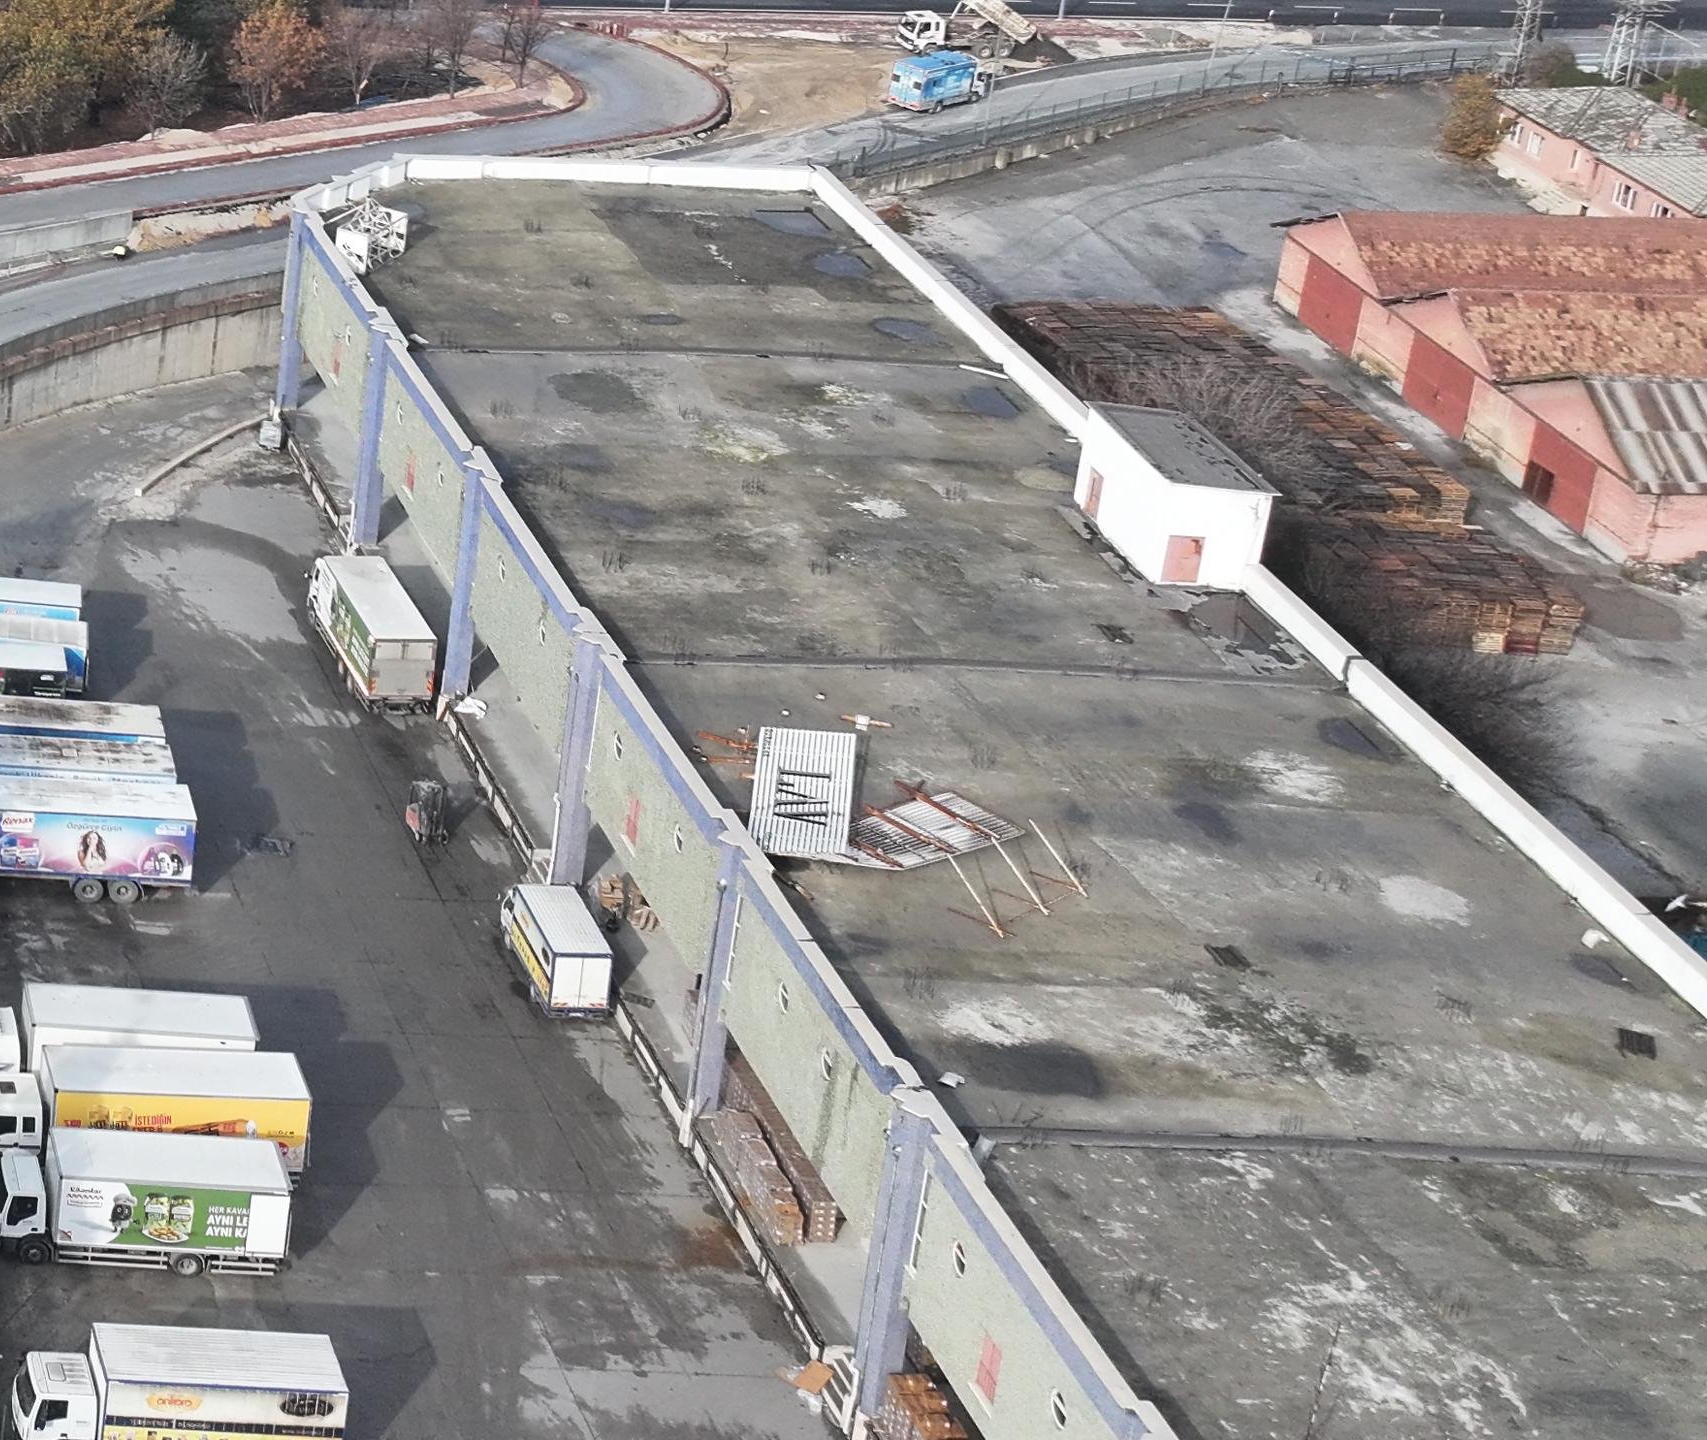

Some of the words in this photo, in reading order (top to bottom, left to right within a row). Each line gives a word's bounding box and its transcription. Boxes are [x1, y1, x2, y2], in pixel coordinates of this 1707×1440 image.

[209, 1206, 225, 1214] HER
[207, 1215, 234, 1227] AYNI
[205, 1226, 233, 1238] AYNI
